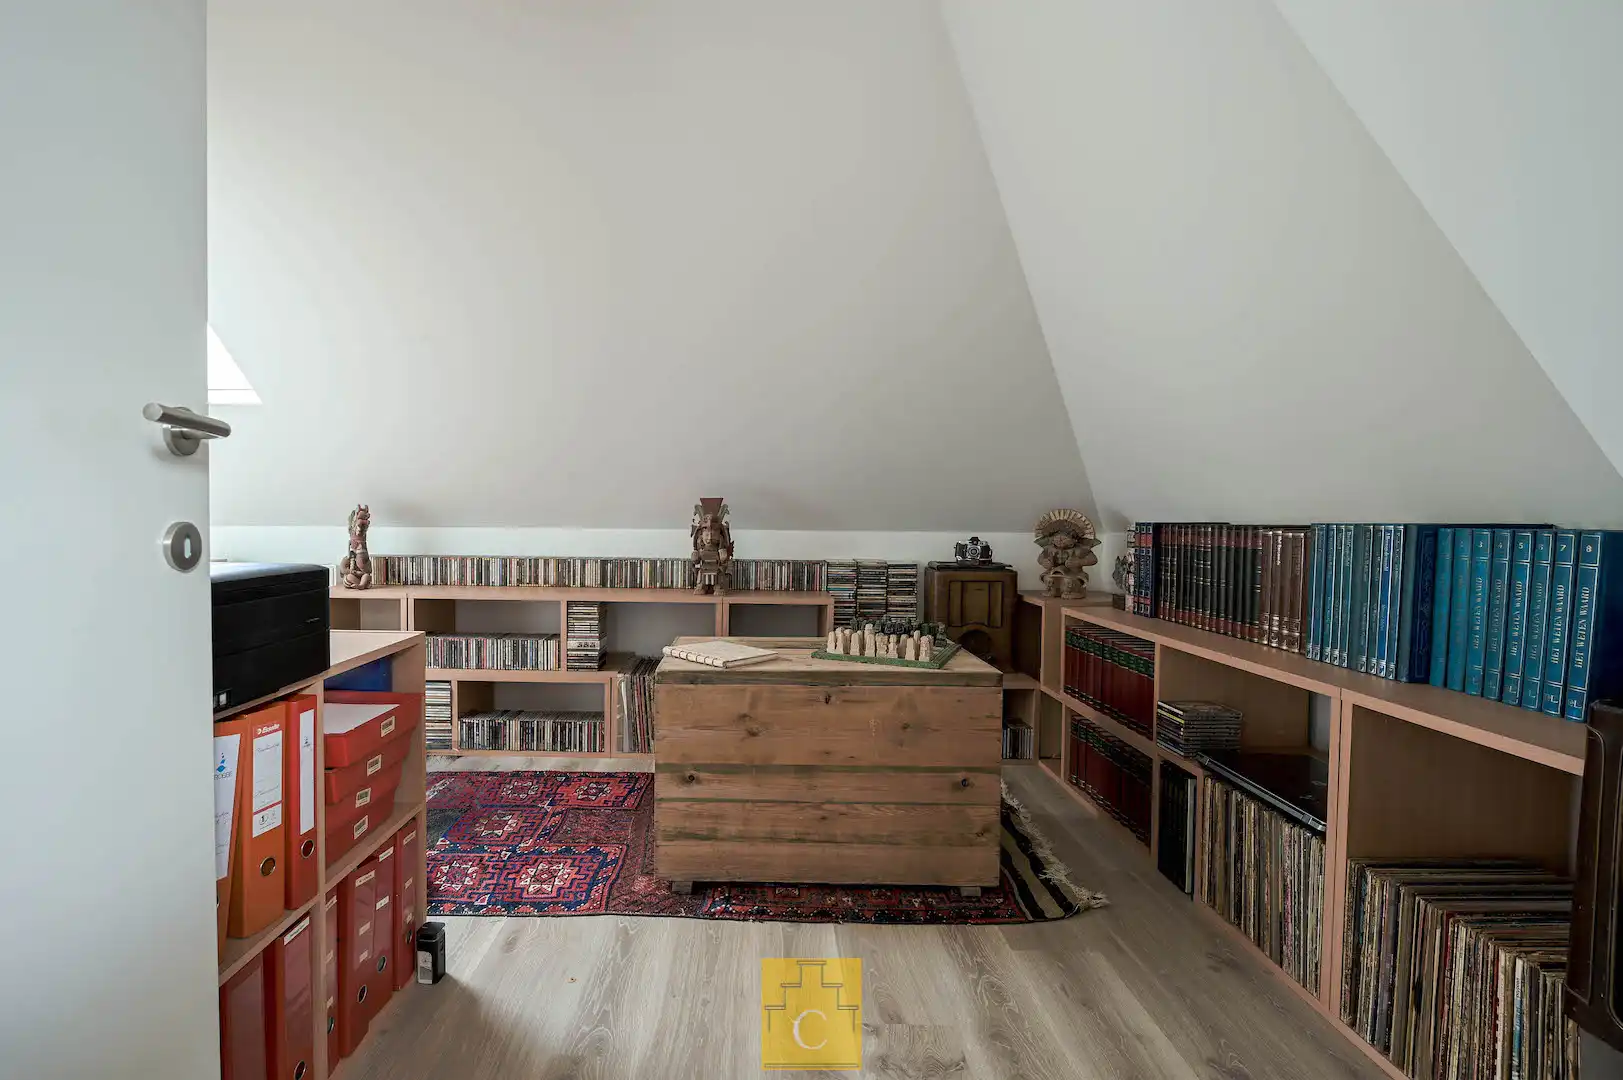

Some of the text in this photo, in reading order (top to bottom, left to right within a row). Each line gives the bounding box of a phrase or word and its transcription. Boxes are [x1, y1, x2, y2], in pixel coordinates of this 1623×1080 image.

[1475, 577, 1483, 602] WAARD
[1510, 581, 1523, 656] HET WETEN WAARD
[1551, 584, 1565, 664] HET WETEN WAARD
[1575, 587, 1590, 668] HET WETEN WAARD
